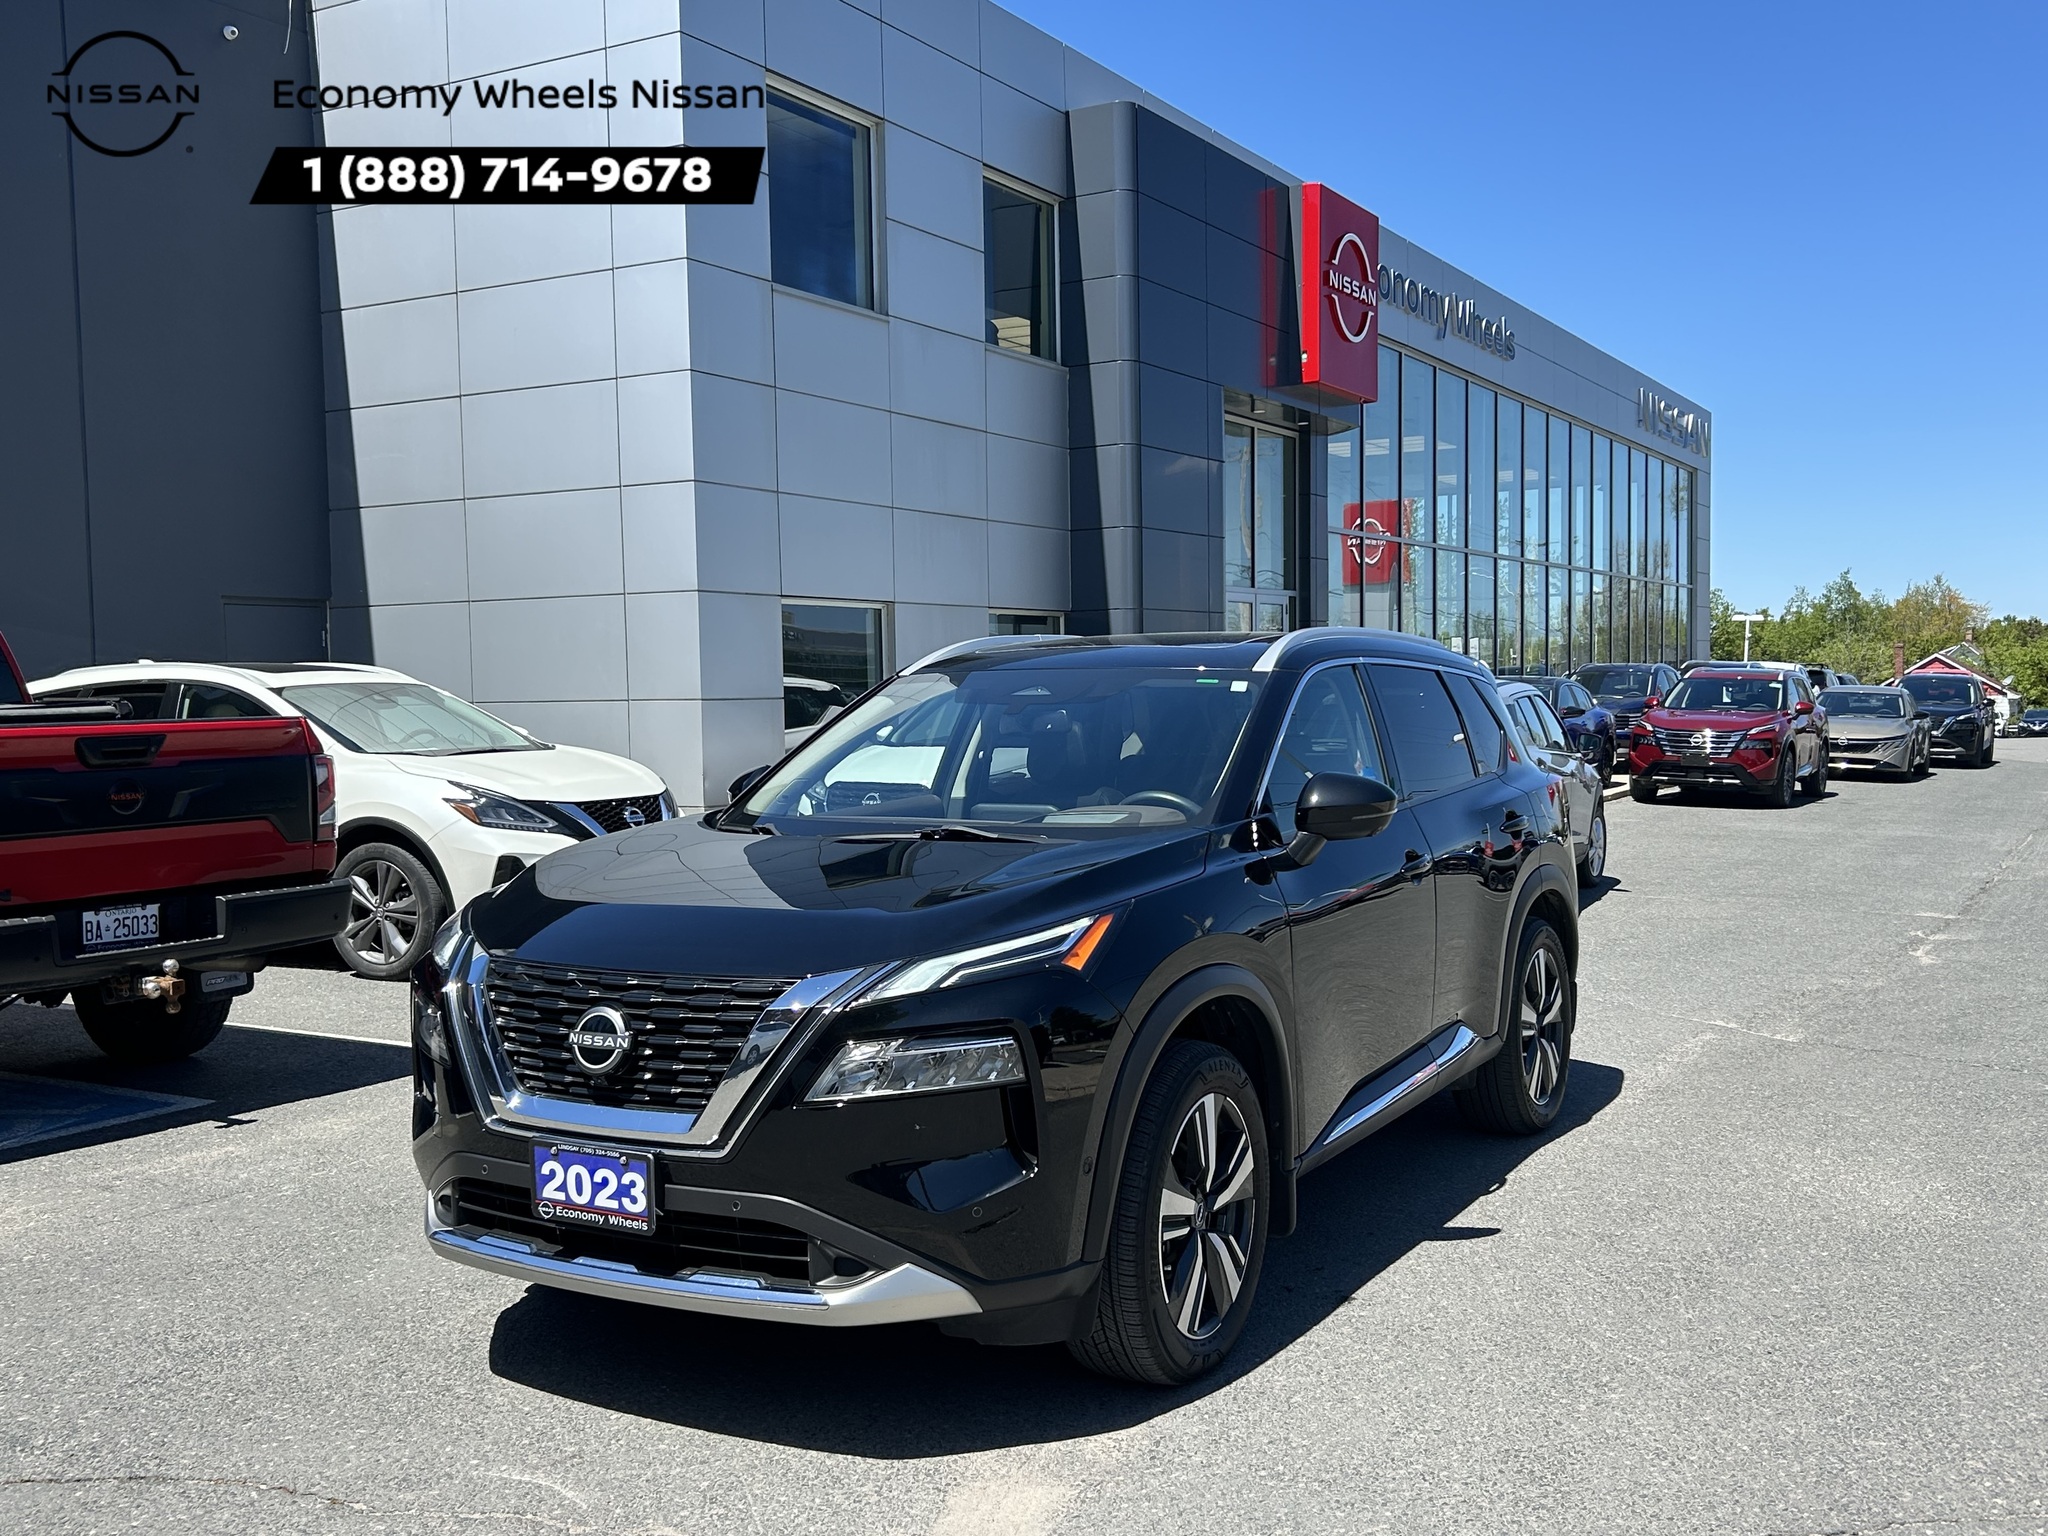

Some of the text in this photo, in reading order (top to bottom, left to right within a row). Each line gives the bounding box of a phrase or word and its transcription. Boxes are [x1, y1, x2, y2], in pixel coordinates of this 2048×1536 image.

[1329, 269, 1377, 307] NISSAN
[1377, 263, 1516, 361] onomy Wheels
[1638, 387, 1708, 458] NISSAN
[110, 792, 145, 801] NISSAN
[569, 1032, 629, 1048] NISSAN
[557, 1144, 579, 1152] LINDSAY
[541, 1160, 647, 1213] 2023
[556, 1206, 605, 1225] Economy
[608, 1215, 648, 1230] Wheels
